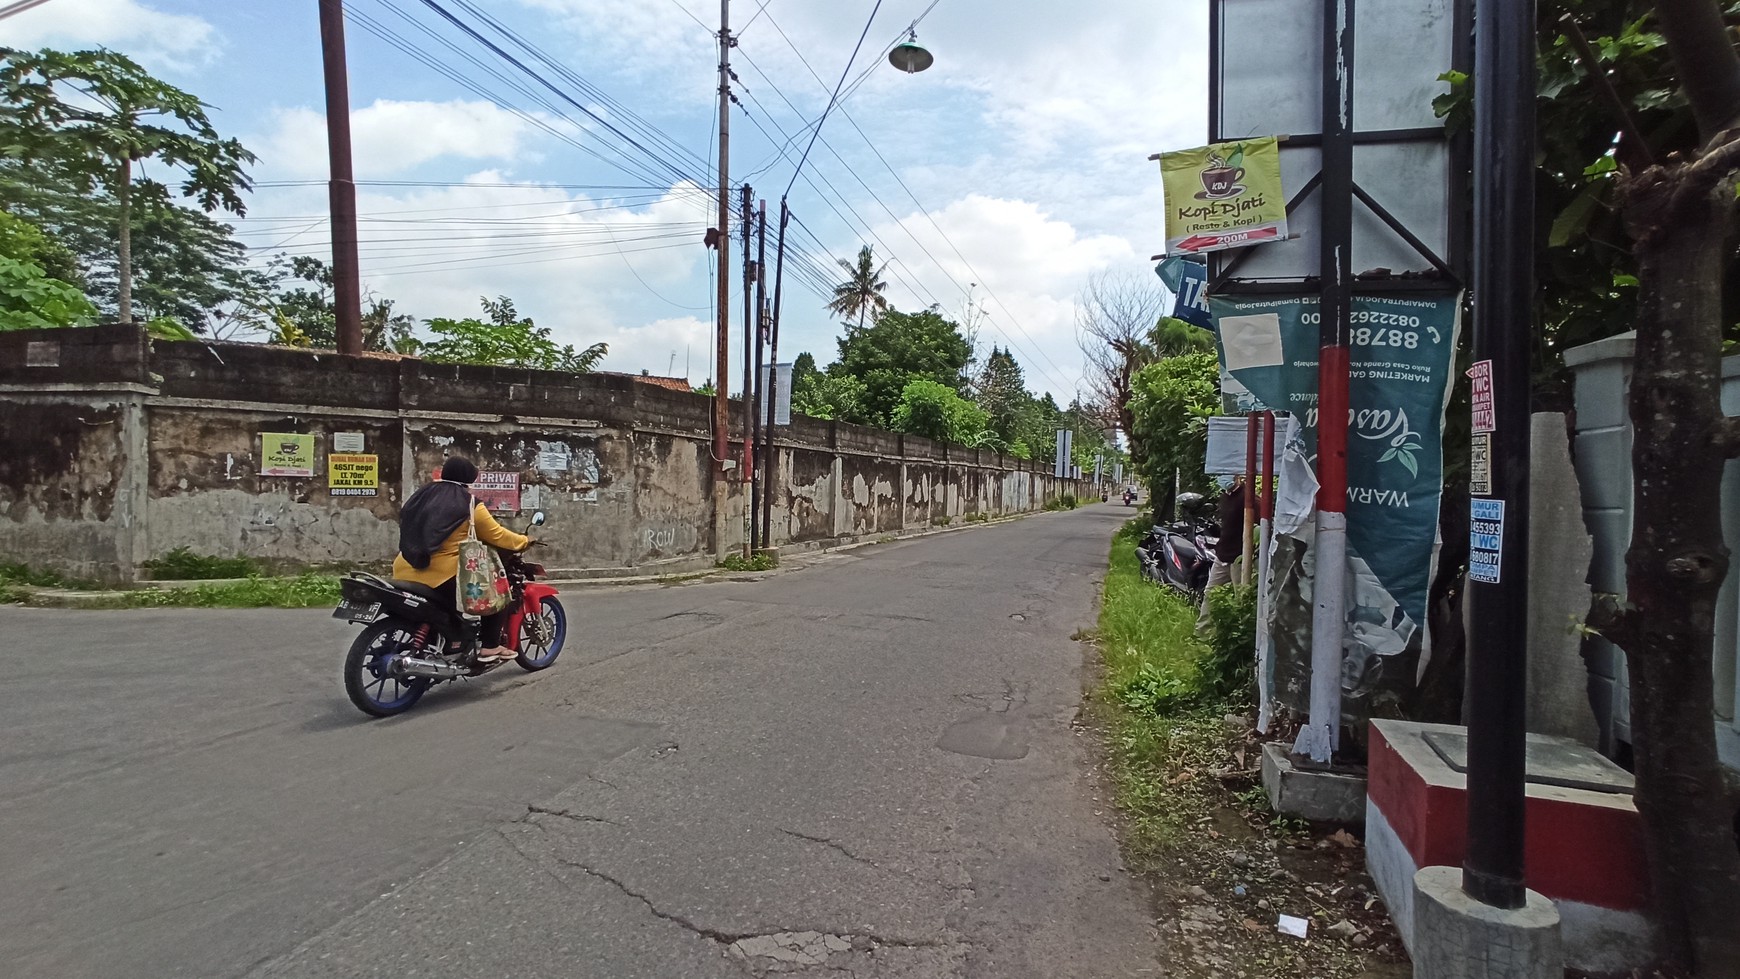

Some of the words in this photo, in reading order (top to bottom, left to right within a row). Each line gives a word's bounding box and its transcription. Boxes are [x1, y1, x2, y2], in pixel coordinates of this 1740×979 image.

[1179, 202, 1218, 220] Kopi
[1220, 193, 1266, 218] Djati
[1192, 222, 1220, 230] Resto
[1234, 216, 1256, 226] Kopi
[1216, 232, 1248, 244] 200M
[1184, 276, 1210, 313] TA
[1368, 370, 1430, 382] MARKETING
[481, 473, 517, 483] PRIVAT
[1474, 510, 1499, 519] GALI
[1480, 534, 1498, 548] WC
